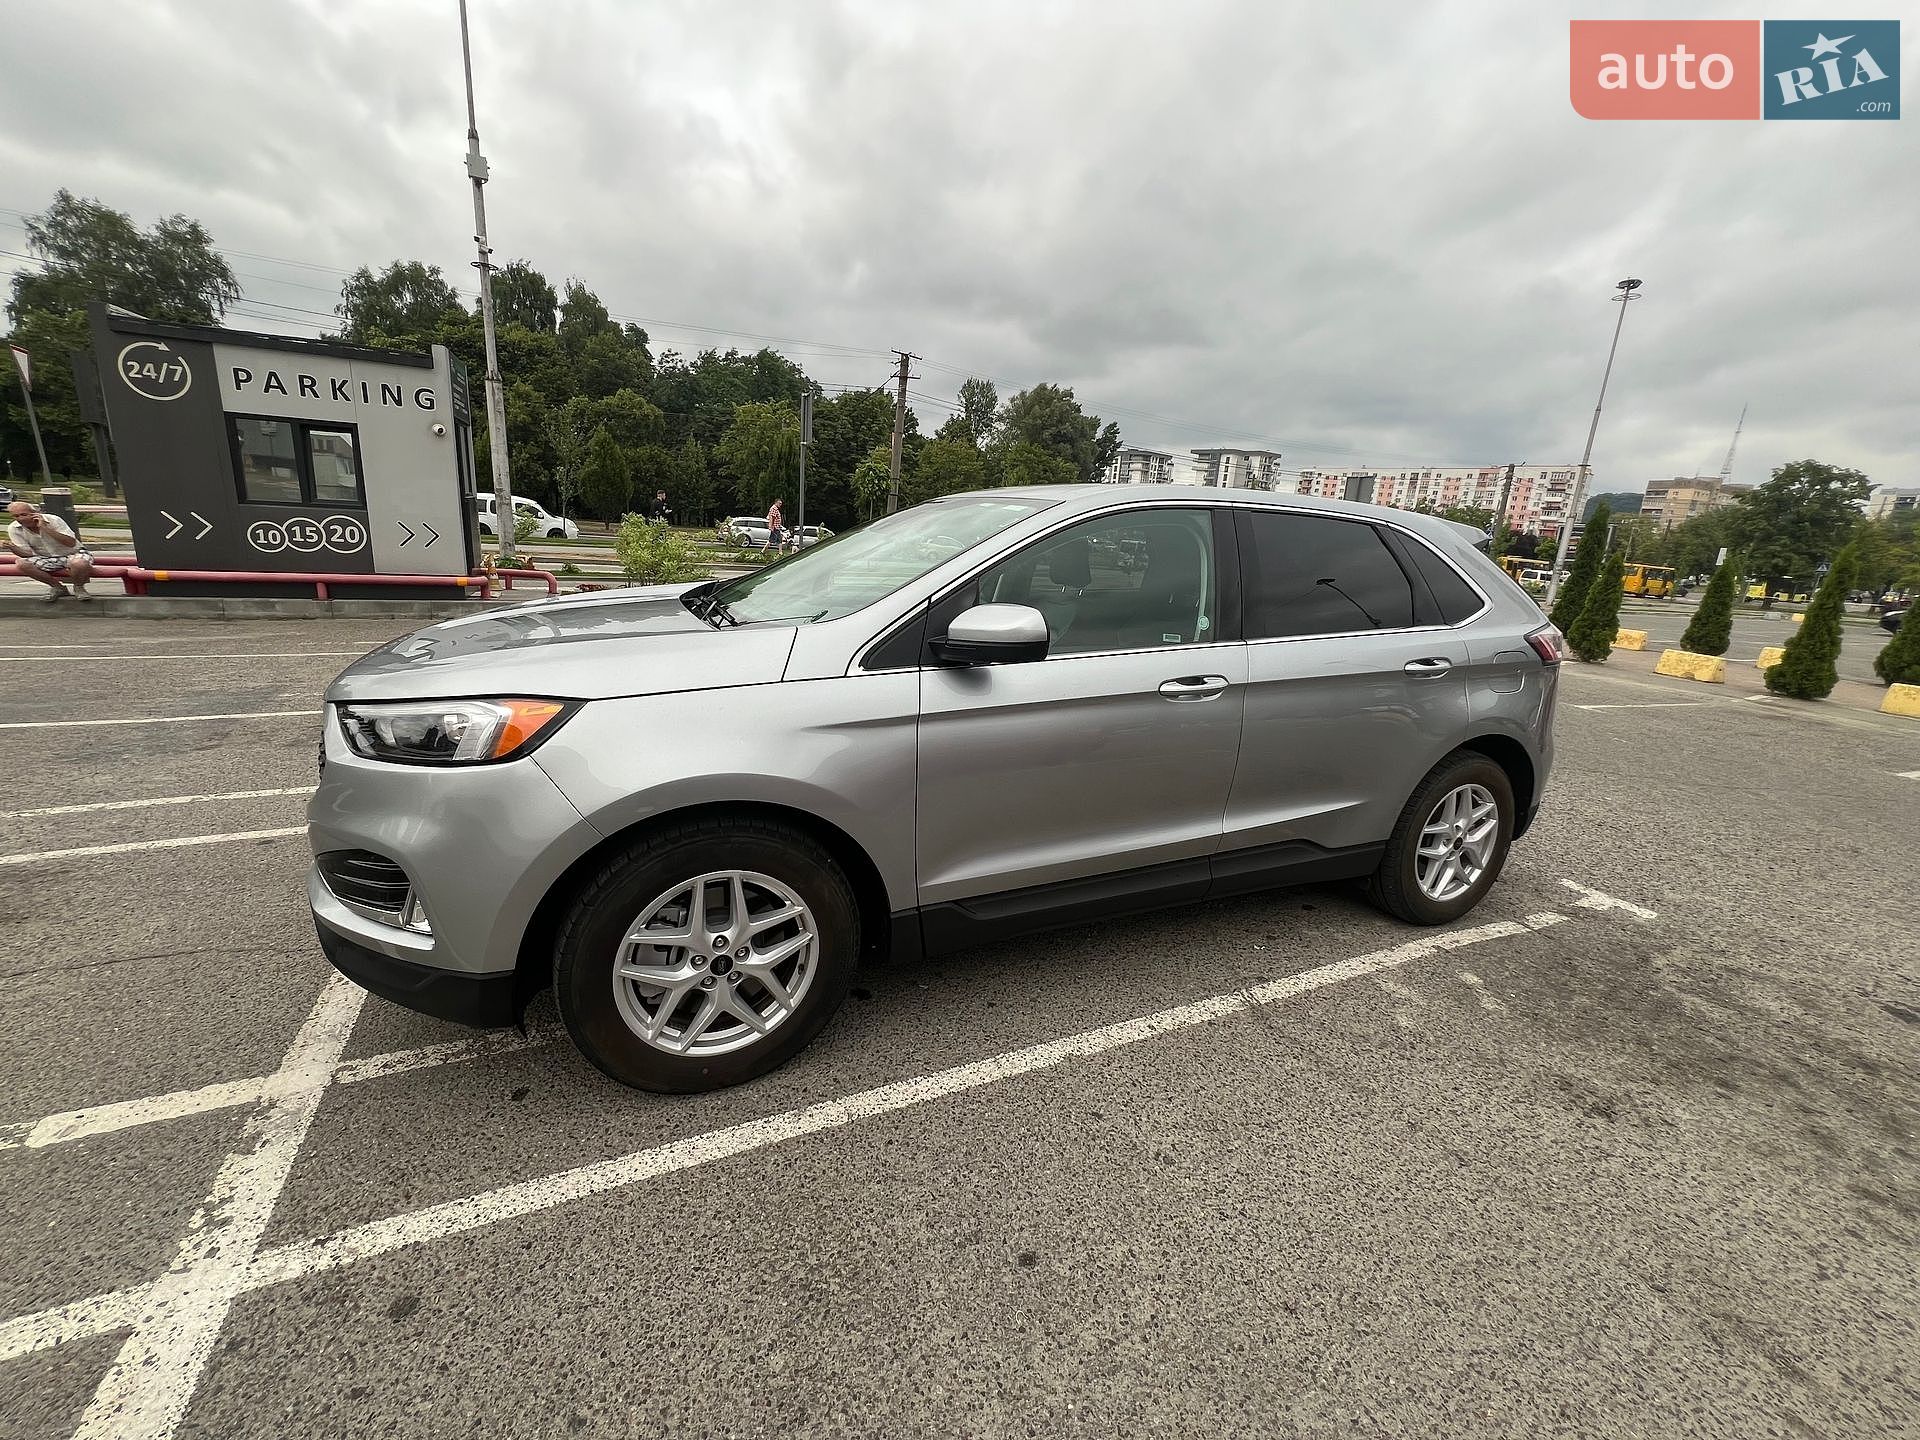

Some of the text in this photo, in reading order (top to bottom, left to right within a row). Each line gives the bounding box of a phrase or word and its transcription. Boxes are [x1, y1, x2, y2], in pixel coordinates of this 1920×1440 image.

[127, 359, 184, 384] 24/7
[231, 365, 437, 412] PARKING
[256, 525, 361, 545] 10 15 20
